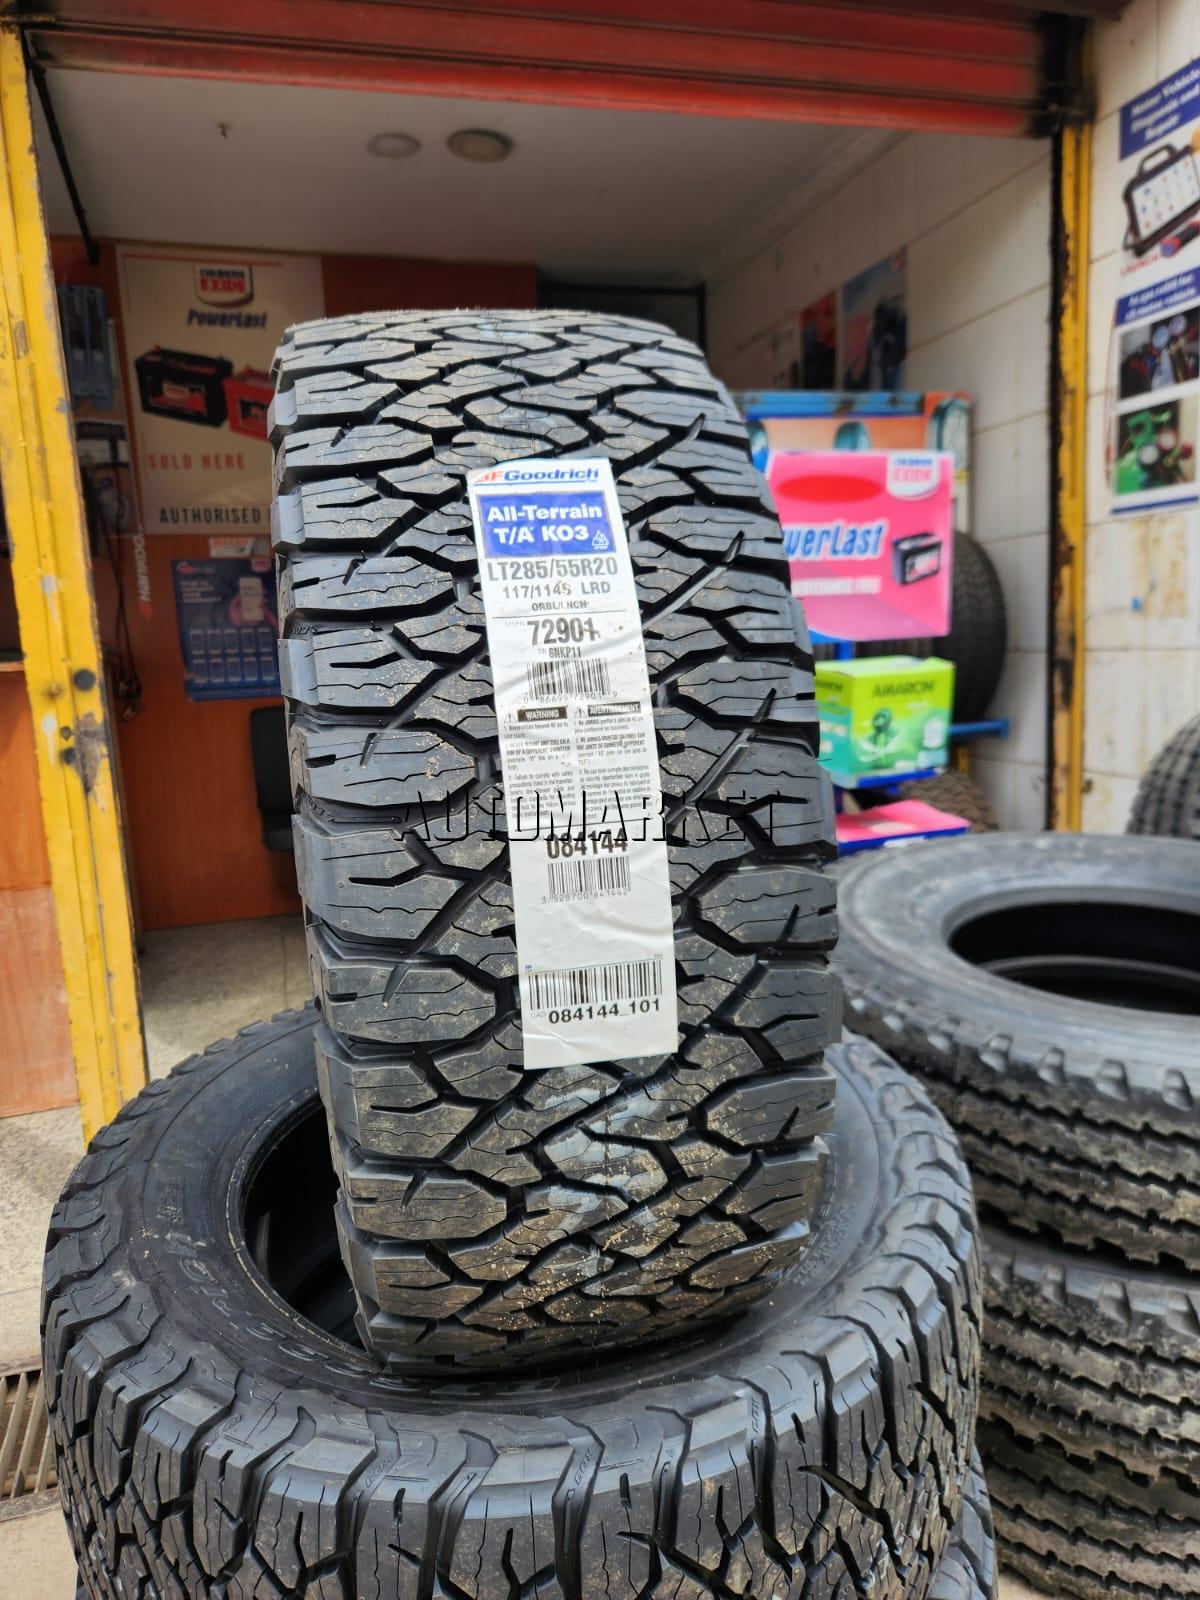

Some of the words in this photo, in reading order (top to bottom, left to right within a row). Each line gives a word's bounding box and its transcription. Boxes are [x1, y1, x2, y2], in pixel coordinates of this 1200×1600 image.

[200, 278, 246, 293] EXIDE
[187, 309, 268, 328] PowerLast
[148, 452, 193, 470] SOLD
[202, 451, 246, 470] HERE
[159, 506, 262, 524] AUTHORISED
[487, 503, 603, 522] All-Terrain
[494, 526, 534, 545] T/A
[542, 525, 590, 542] KO3
[783, 524, 884, 557] werLast
[487, 557, 618, 581] LT285/55R20
[581, 581, 611, 595] LRD
[527, 617, 597, 645] 72901
[525, 708, 560, 720] WARNING
[546, 828, 628, 859] 084144
[548, 997, 660, 1025] 084144_101
